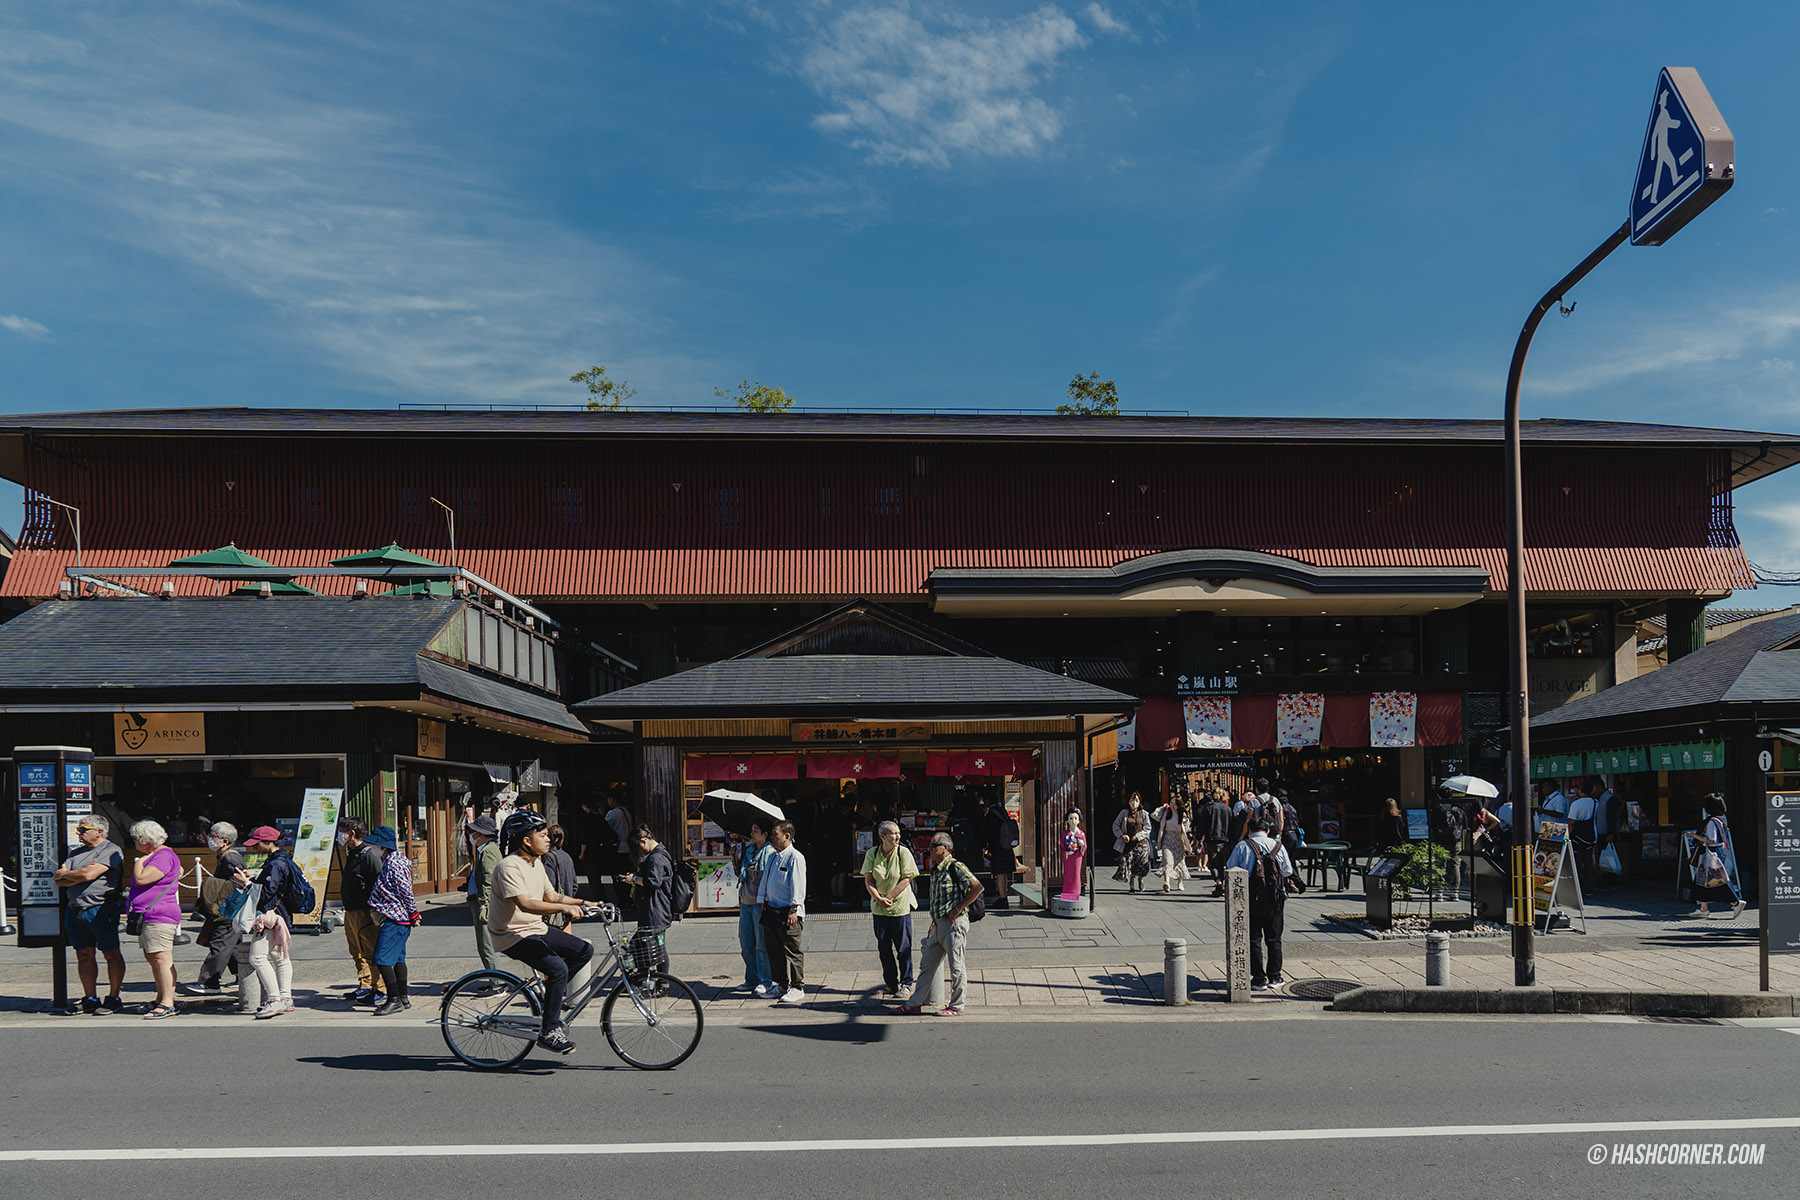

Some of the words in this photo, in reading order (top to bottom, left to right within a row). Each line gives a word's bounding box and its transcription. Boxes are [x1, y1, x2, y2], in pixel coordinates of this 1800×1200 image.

[1193, 676, 1238, 689] 嵐山駅
[154, 730, 200, 738] ARINCO
[33, 816, 45, 870] 嵐山天龍寺前
[712, 868, 725, 903] 夕子
[1775, 886, 1800, 895] 竹林の
